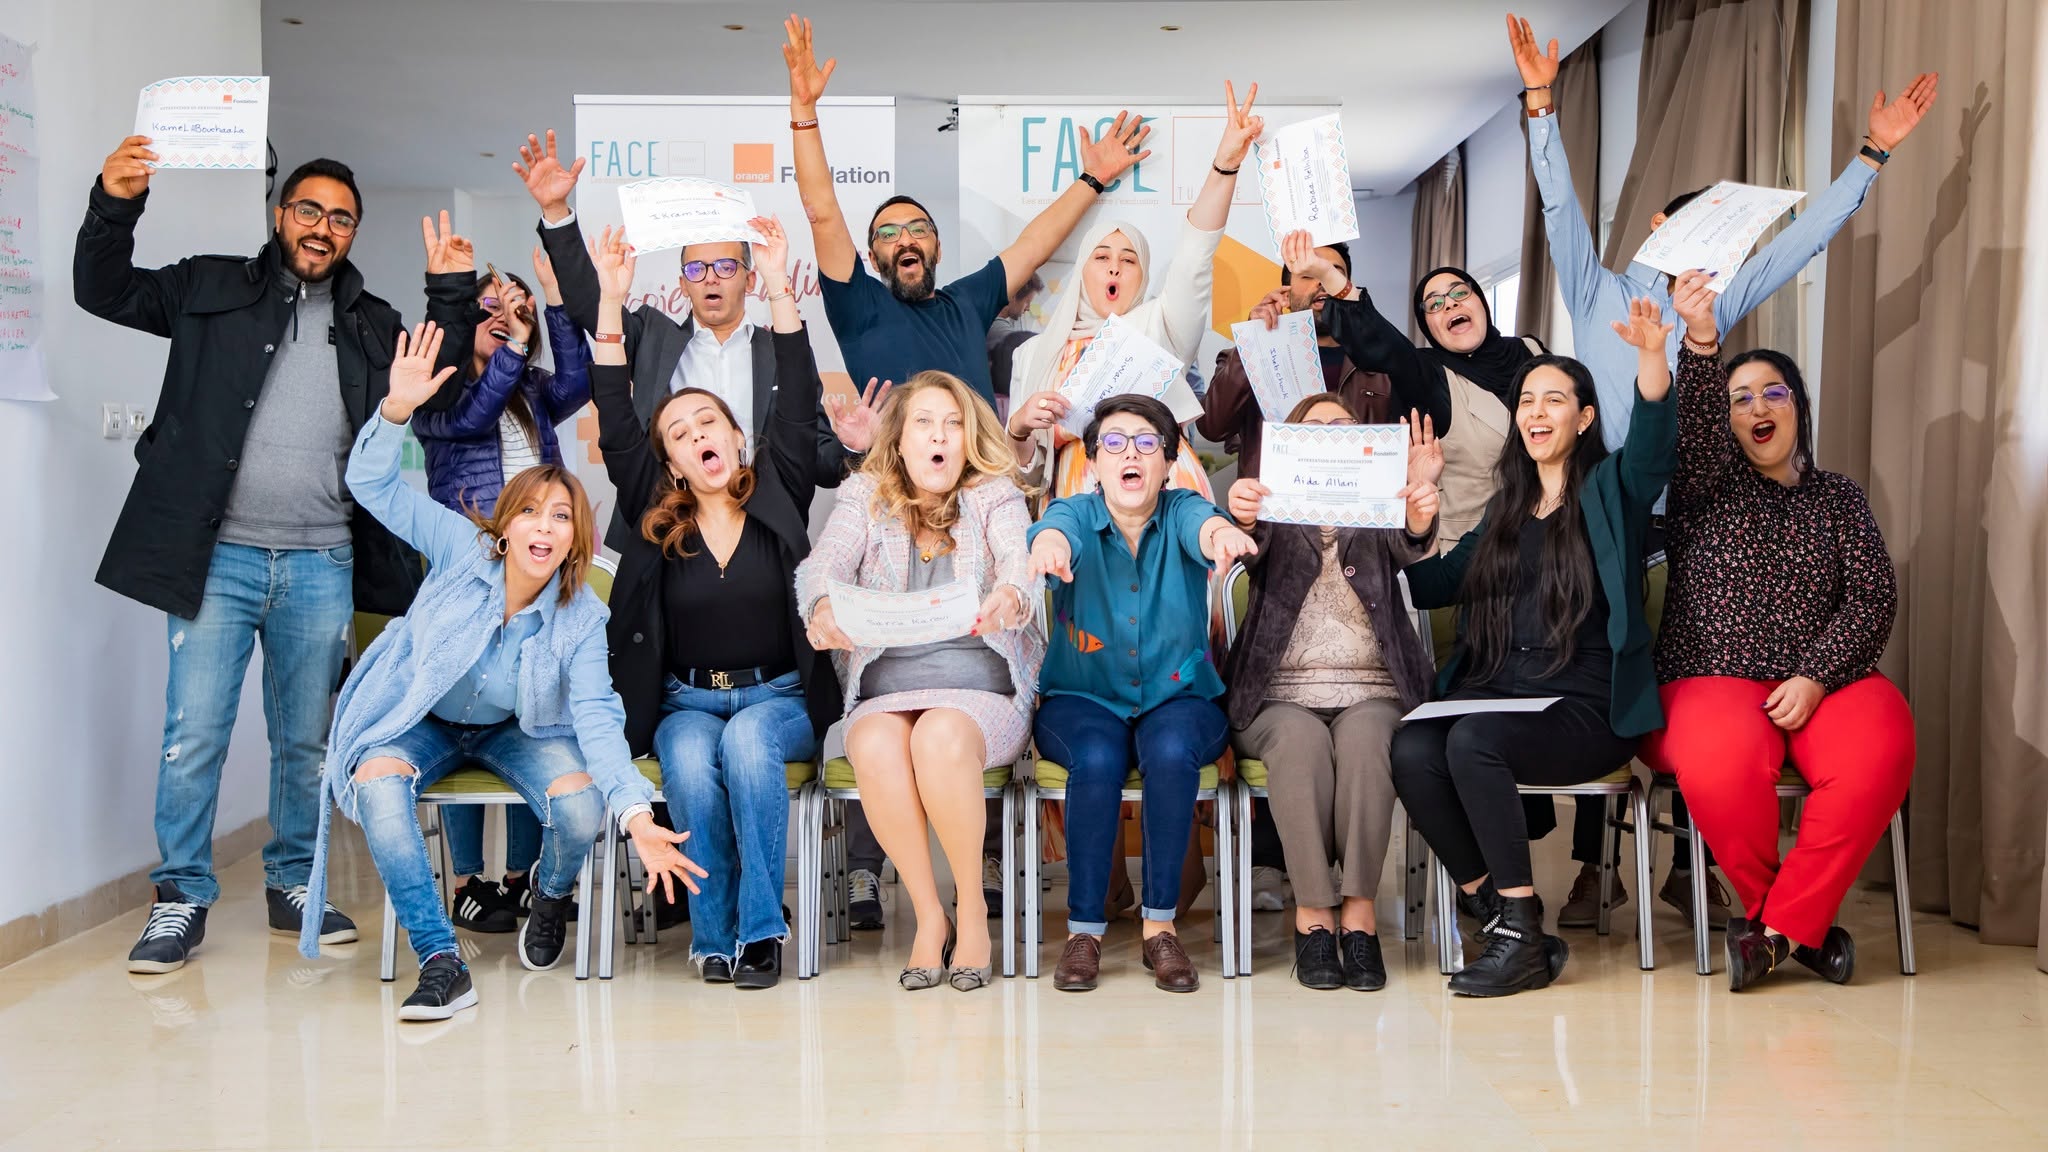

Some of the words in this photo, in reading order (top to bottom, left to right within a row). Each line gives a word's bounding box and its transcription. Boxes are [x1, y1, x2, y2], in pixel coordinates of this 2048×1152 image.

[591, 141, 660, 177] FACE
[735, 172, 770, 183] orange
[781, 166, 890, 183] Fation
